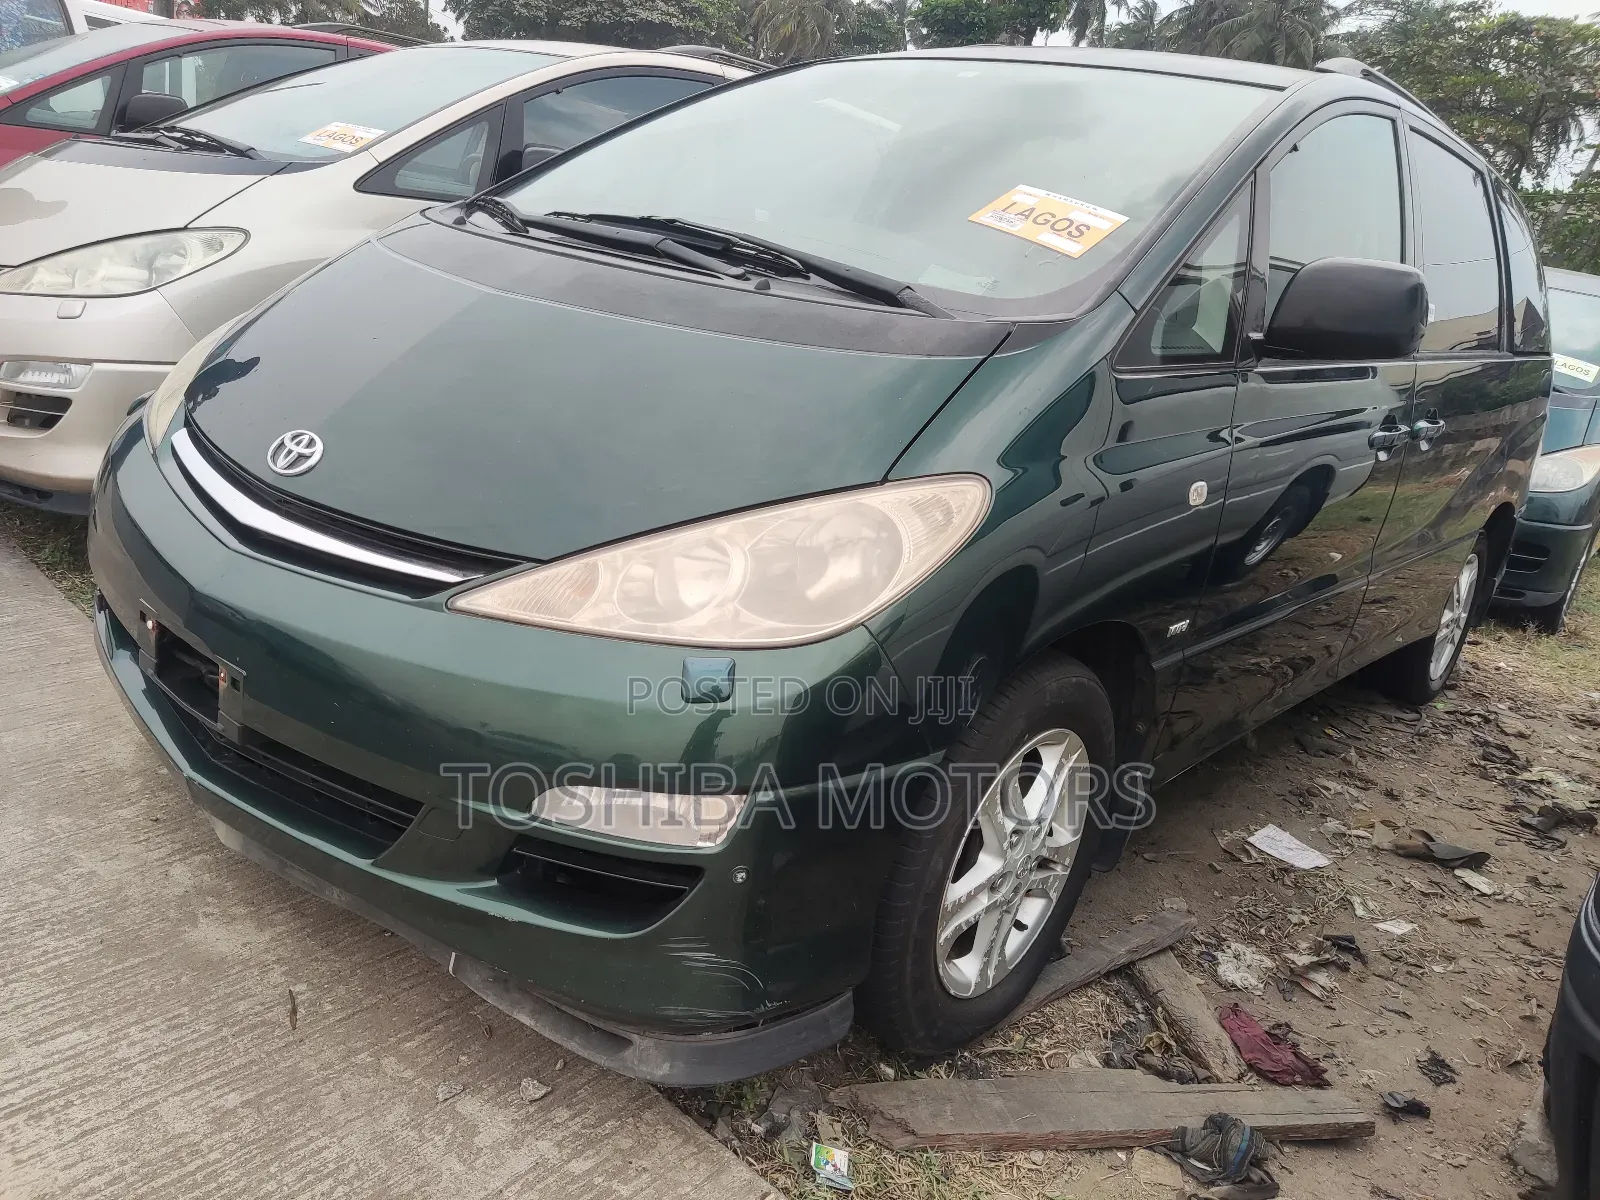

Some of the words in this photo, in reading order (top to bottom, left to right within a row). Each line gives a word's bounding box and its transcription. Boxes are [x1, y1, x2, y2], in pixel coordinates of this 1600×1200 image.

[316, 130, 364, 145] LAGOS
[1001, 201, 1091, 239] LAGOS
[1554, 360, 1591, 376] LAGOS
